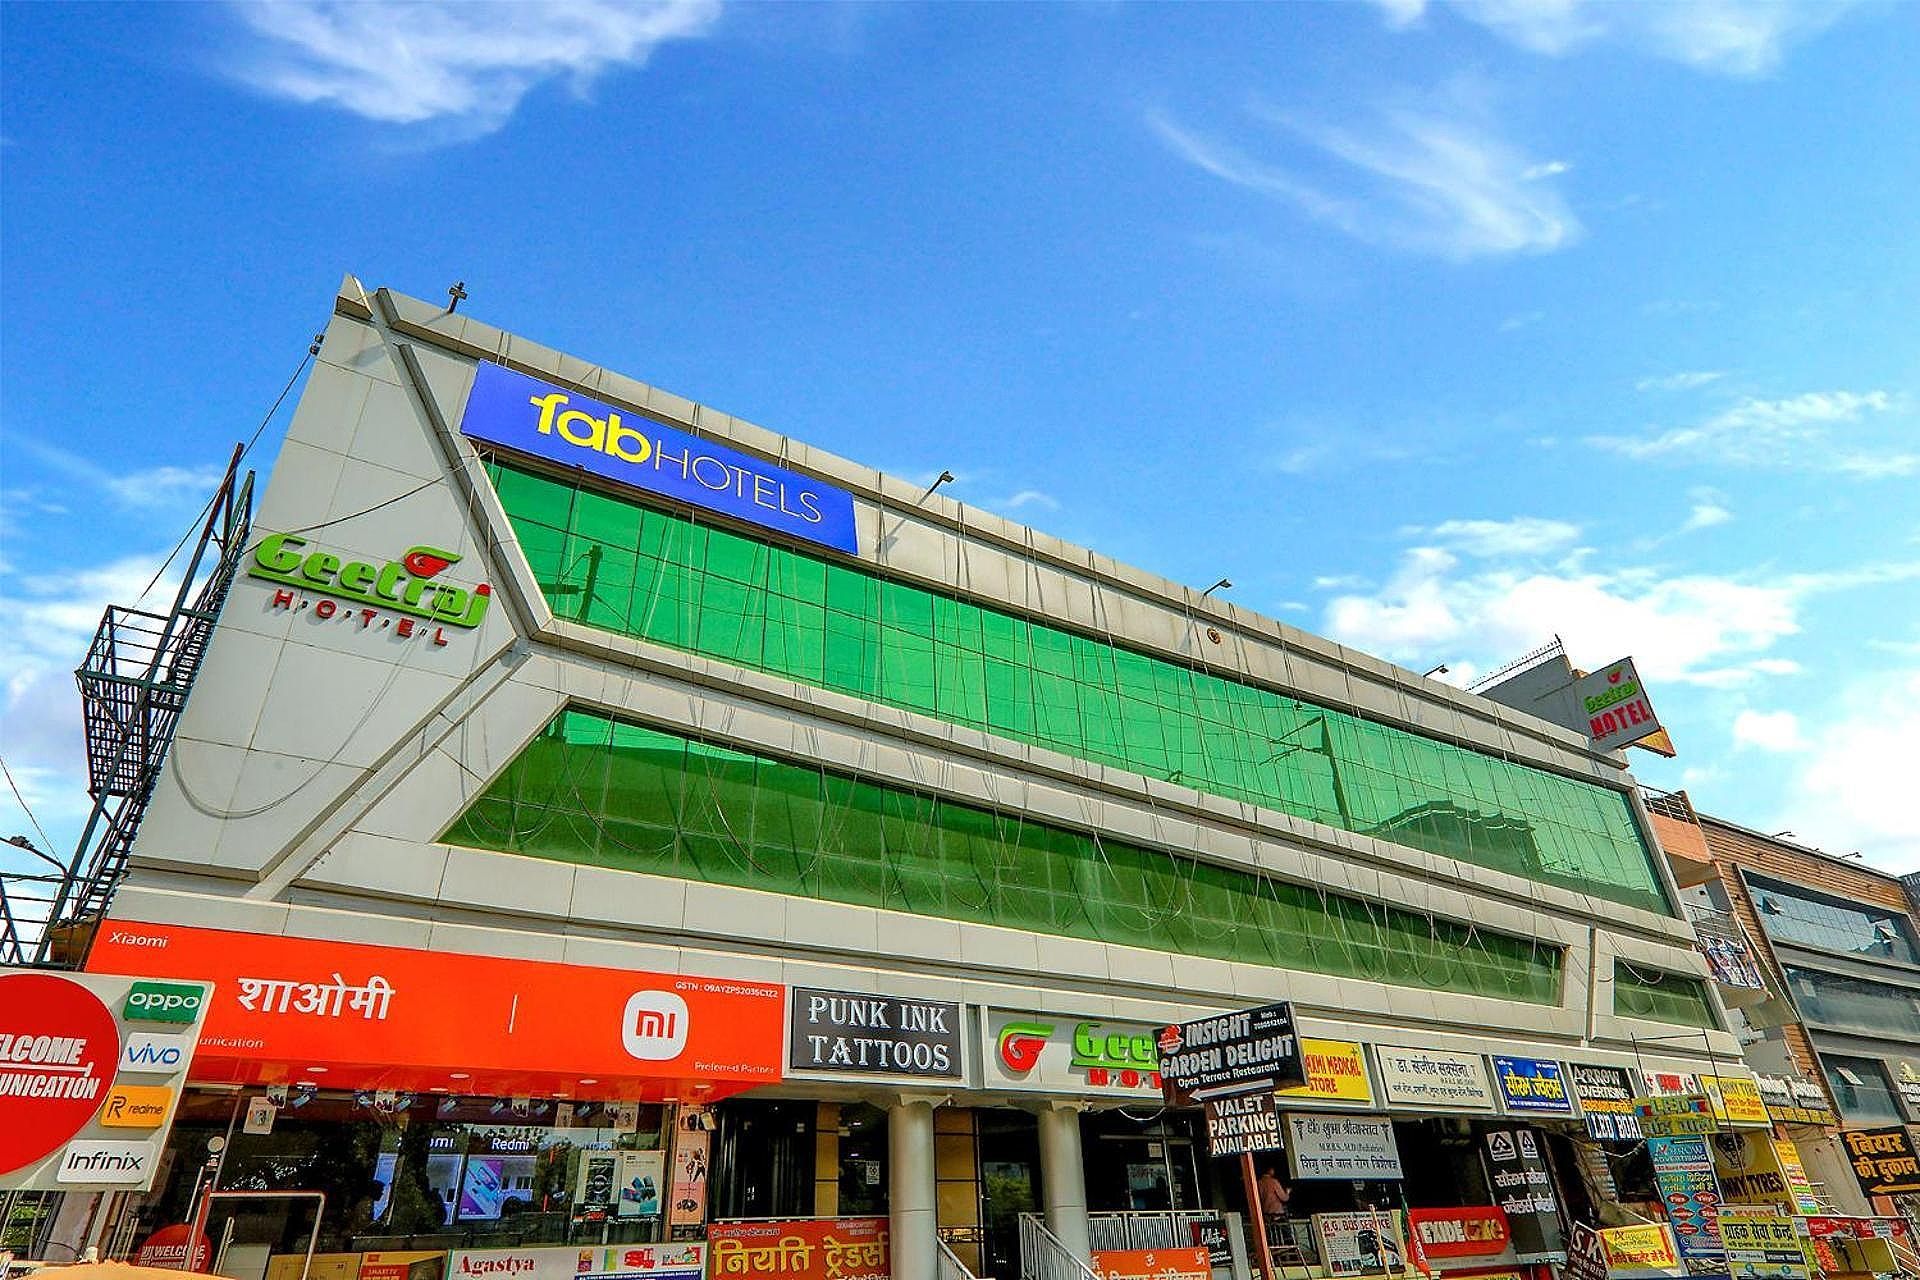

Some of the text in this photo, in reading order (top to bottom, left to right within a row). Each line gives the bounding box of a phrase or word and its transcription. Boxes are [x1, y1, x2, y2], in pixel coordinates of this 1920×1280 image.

[529, 393, 822, 523] fabHOTELS
[248, 533, 491, 628] Geetraj
[1589, 699, 1653, 741] HOTEL
[109, 932, 169, 948] Xiaomi
[237, 972, 396, 1020] शाओमी
[675, 981, 699, 991] GSTN
[129, 991, 199, 1010] oppo
[808, 996, 950, 1034] PUNK INK
[1185, 1013, 1251, 1048] INSIGHT
[128, 1042, 180, 1064] vivo
[200, 1037, 264, 1049] unication
[807, 1034, 950, 1072] TATTOOS
[1073, 1022, 1154, 1070] Gee
[1160, 1034, 1294, 1079] GARDEN DELIGHT
[1326, 1055, 1361, 1077] MEDICAL
[0, 1073, 101, 1099] UNICATION
[1178, 1078, 1200, 1090] Open
[1201, 1072, 1231, 1084] Terrace
[1309, 1077, 1338, 1094] STORE
[128, 1104, 164, 1115] realme
[1213, 1096, 1263, 1117] VALET
[1208, 1111, 1277, 1137] PARKING
[491, 1138, 530, 1151] Redmi
[1211, 1132, 1281, 1156] AVAILABLE
[67, 1151, 144, 1170] Infinix
[1853, 1156, 1920, 1183] की दुकान
[1418, 1220, 1466, 1244] EXIDE
[458, 1256, 536, 1273] Agastya
[713, 1231, 888, 1279] नियति ट्रेडर्स
